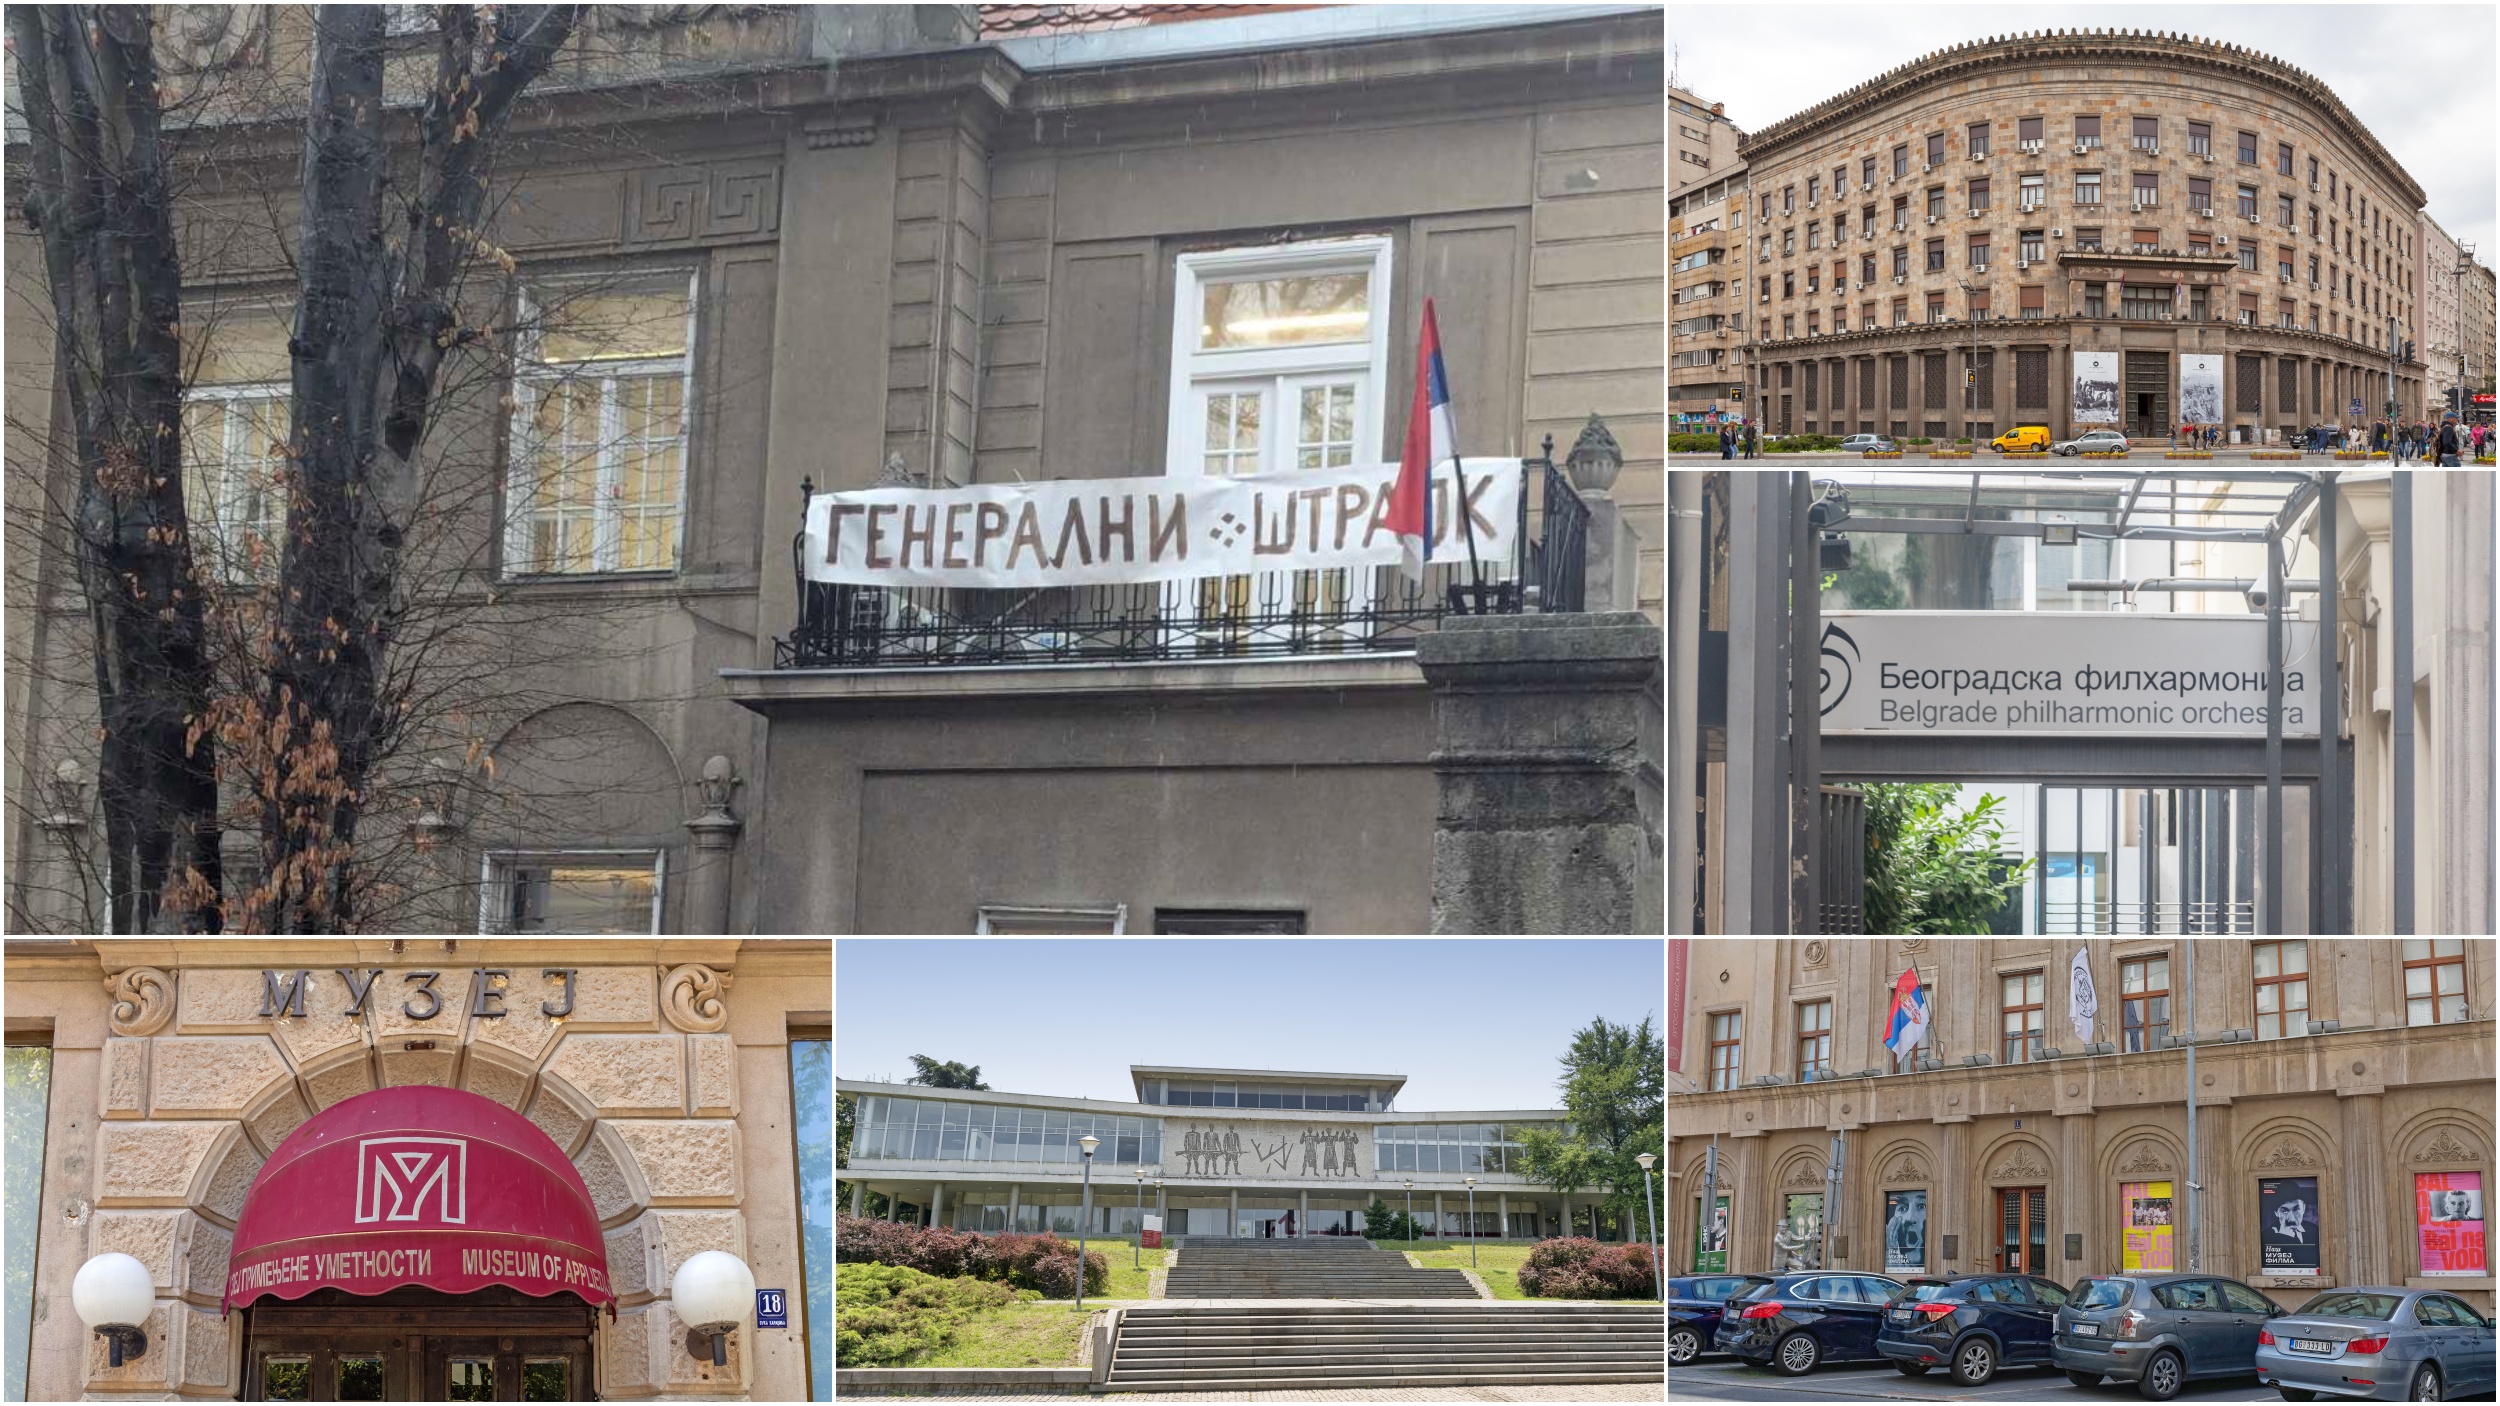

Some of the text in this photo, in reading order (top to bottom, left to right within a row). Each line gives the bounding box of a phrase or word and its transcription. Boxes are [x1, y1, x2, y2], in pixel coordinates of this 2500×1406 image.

[826, 493, 1188, 571] ГЕНЕРАЛНИ
[1880, 662, 2062, 696] Београдска
[1880, 699, 2303, 728] Belgrade philharmonic orchesra
[258, 968, 578, 1020] МУЗЕЈ
[315, 1249, 431, 1280] УМЕТНОСТИ
[462, 1248, 540, 1278] MUSEUM
[543, 1254, 561, 1281] OF
[762, 1294, 781, 1313] 18
